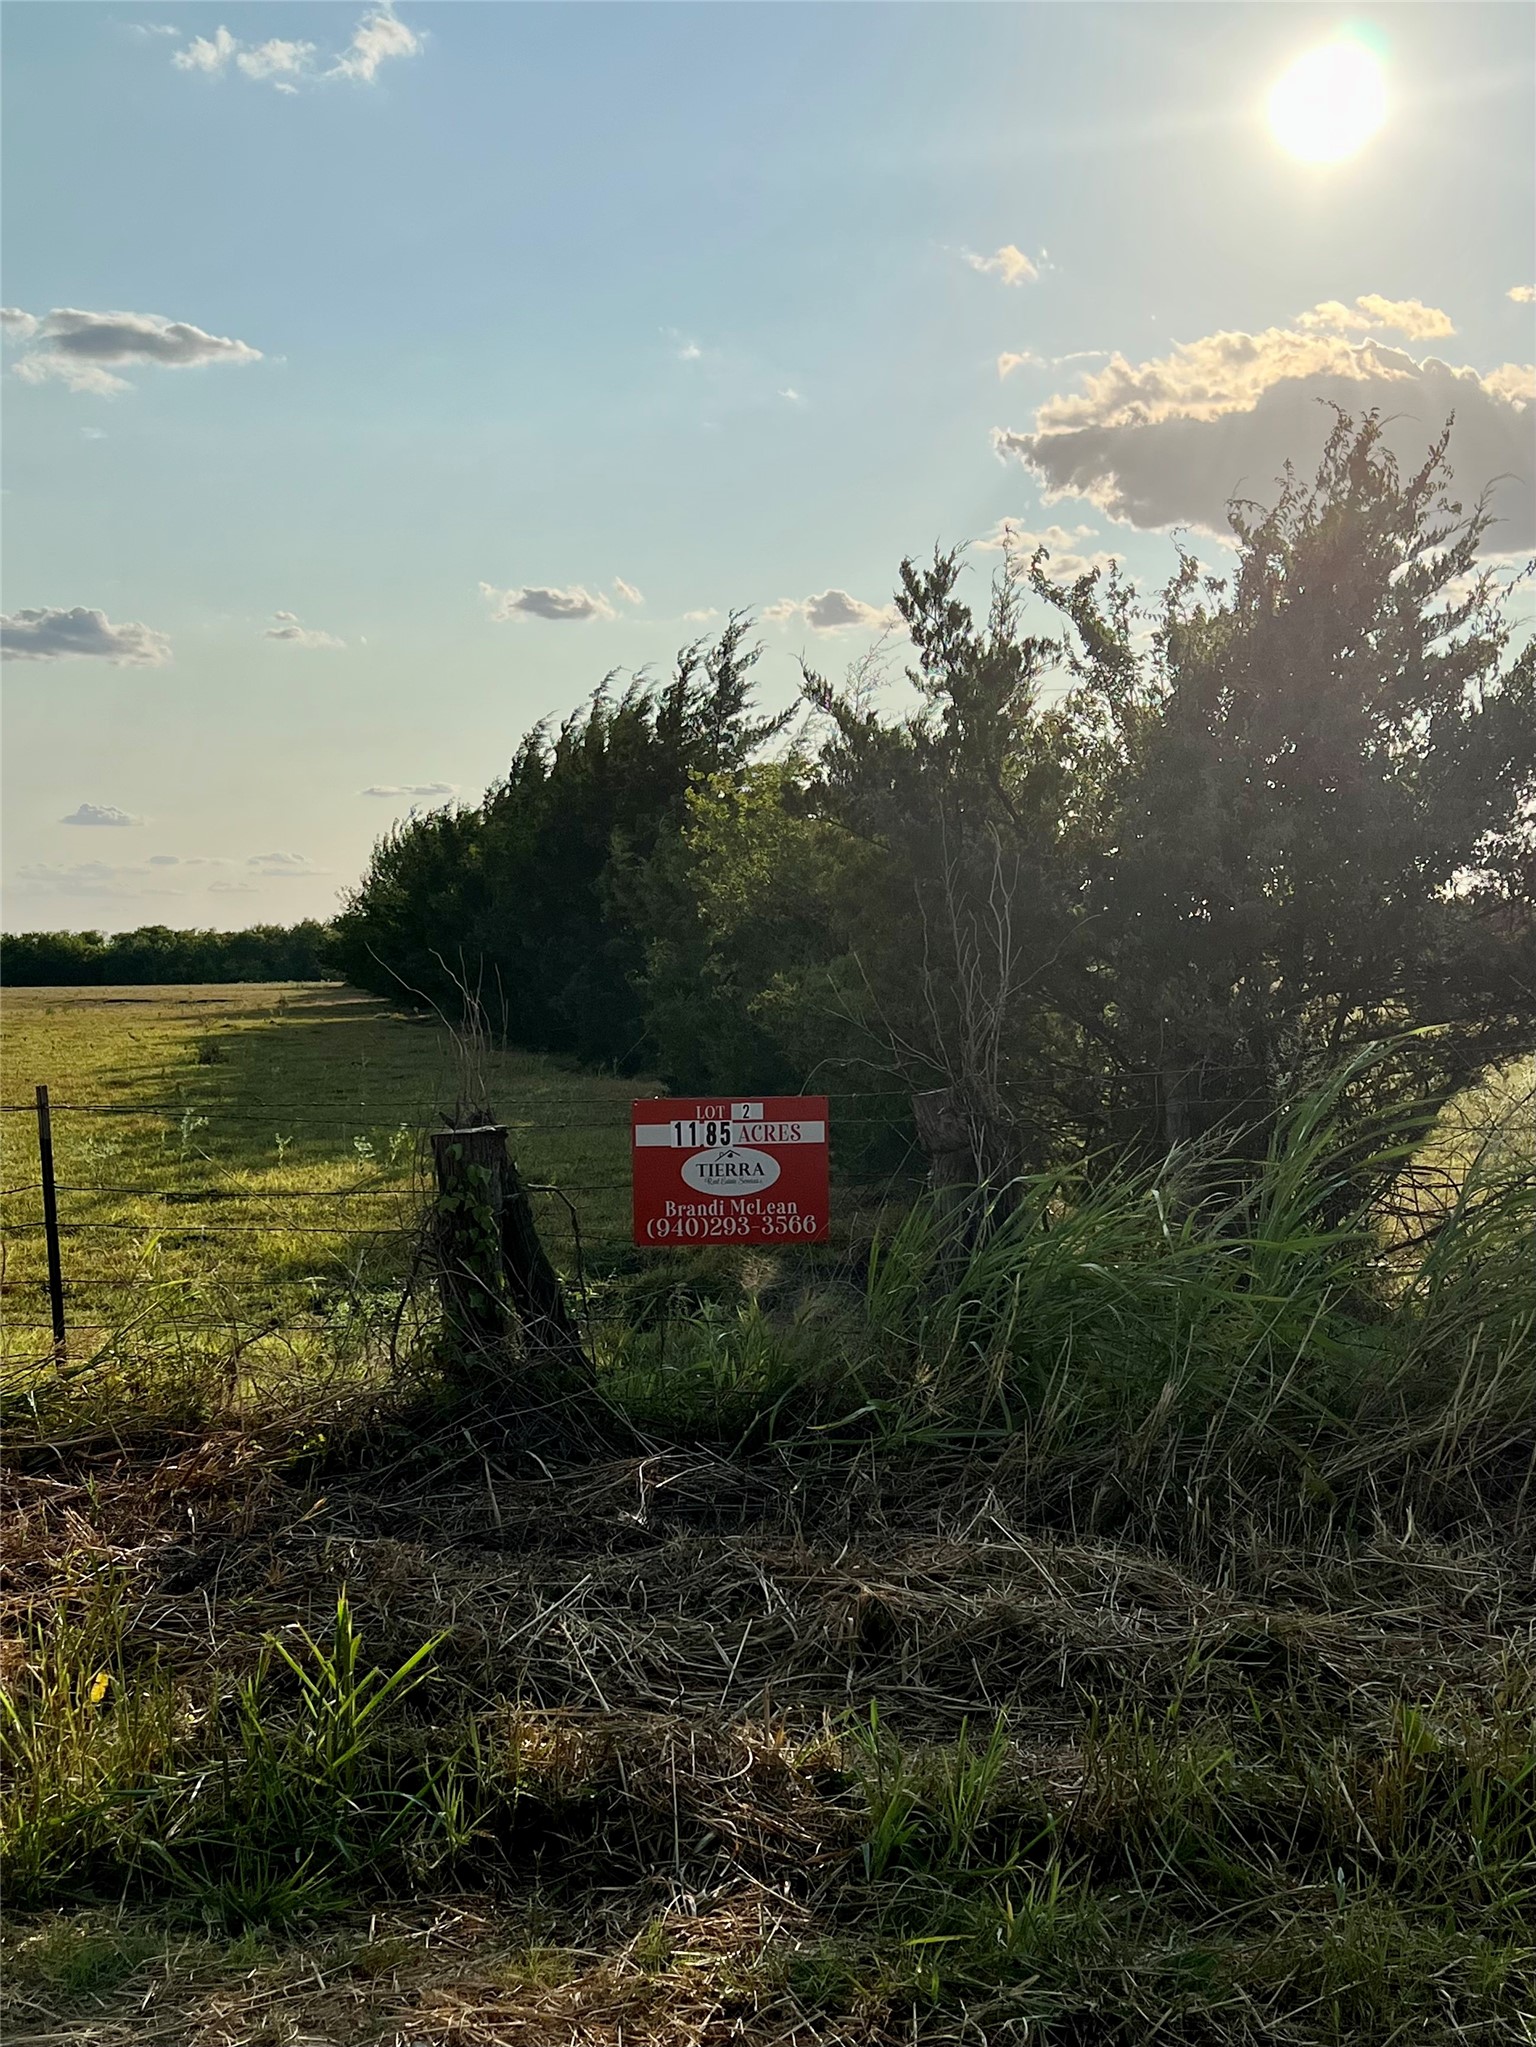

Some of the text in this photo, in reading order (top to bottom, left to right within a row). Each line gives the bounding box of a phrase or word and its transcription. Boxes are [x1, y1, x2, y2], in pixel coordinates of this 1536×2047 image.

[696, 1104, 750, 1119] LOT 2
[738, 1123, 801, 1142] ACRES
[696, 1163, 765, 1177] TIERRA
[665, 1199, 797, 1217] Brandi McLean
[647, 1214, 817, 1239] (940)293-3566
